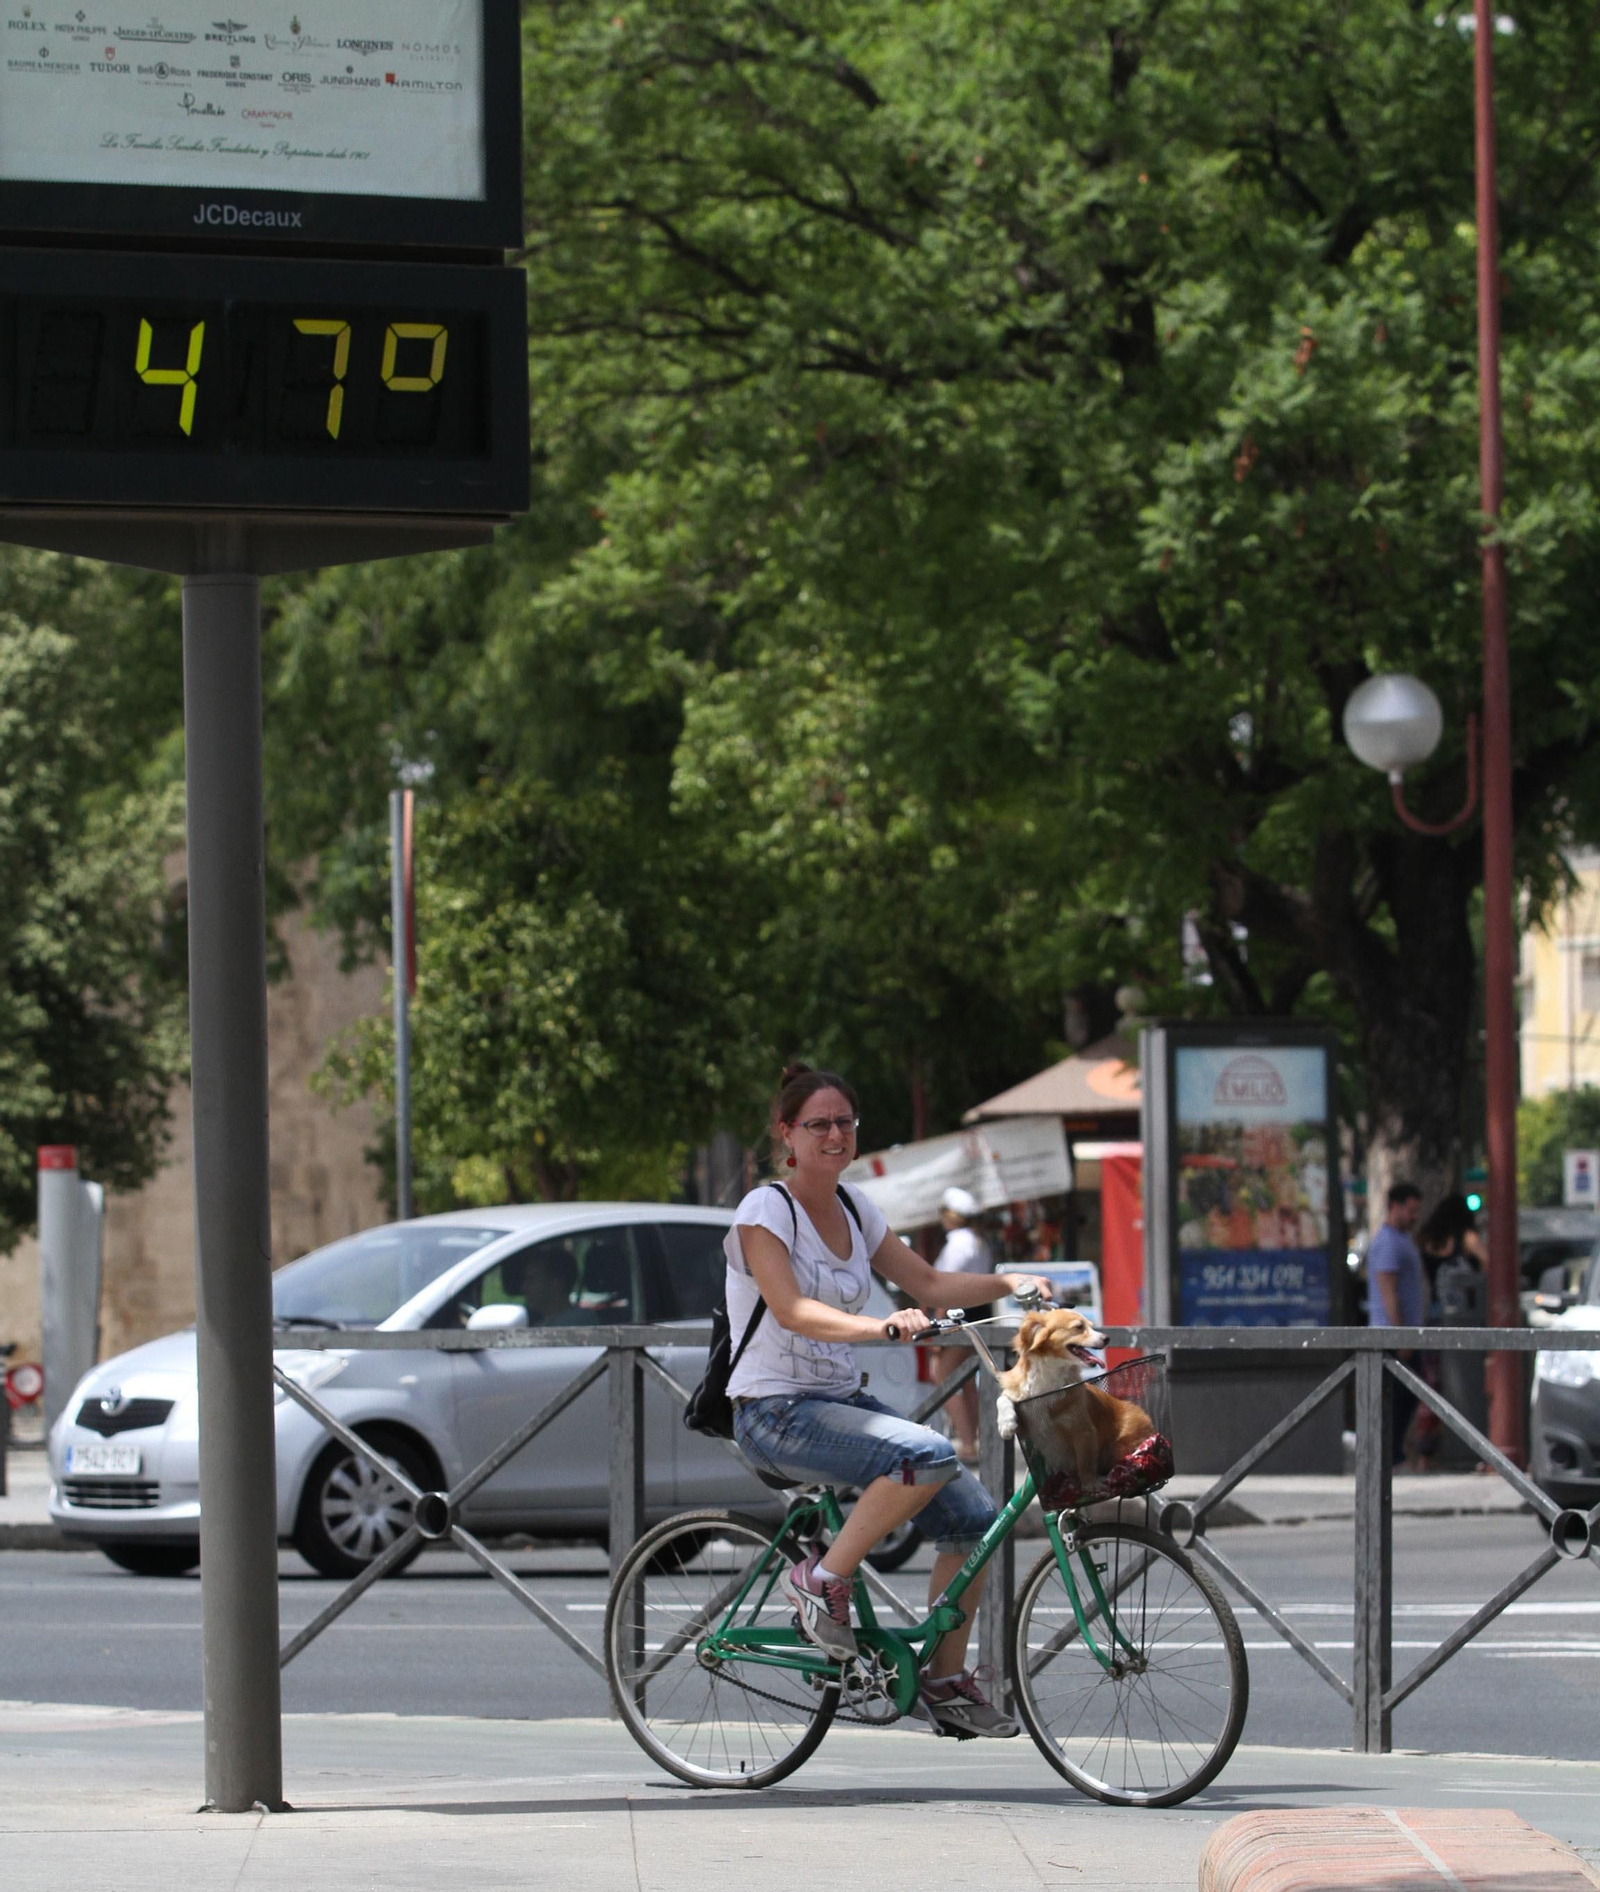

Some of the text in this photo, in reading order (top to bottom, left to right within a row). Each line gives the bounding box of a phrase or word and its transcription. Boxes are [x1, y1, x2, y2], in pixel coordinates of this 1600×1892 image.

[7, 20, 47, 31] ROLEX
[204, 33, 256, 44] BREITLING
[336, 38, 394, 50] LONGINES
[401, 42, 461, 54] NOMOS
[89, 62, 131, 74] TUDOR
[282, 71, 312, 83] ORIS
[320, 75, 381, 87] JUNGHANS
[193, 203, 303, 227] JCDecaux
